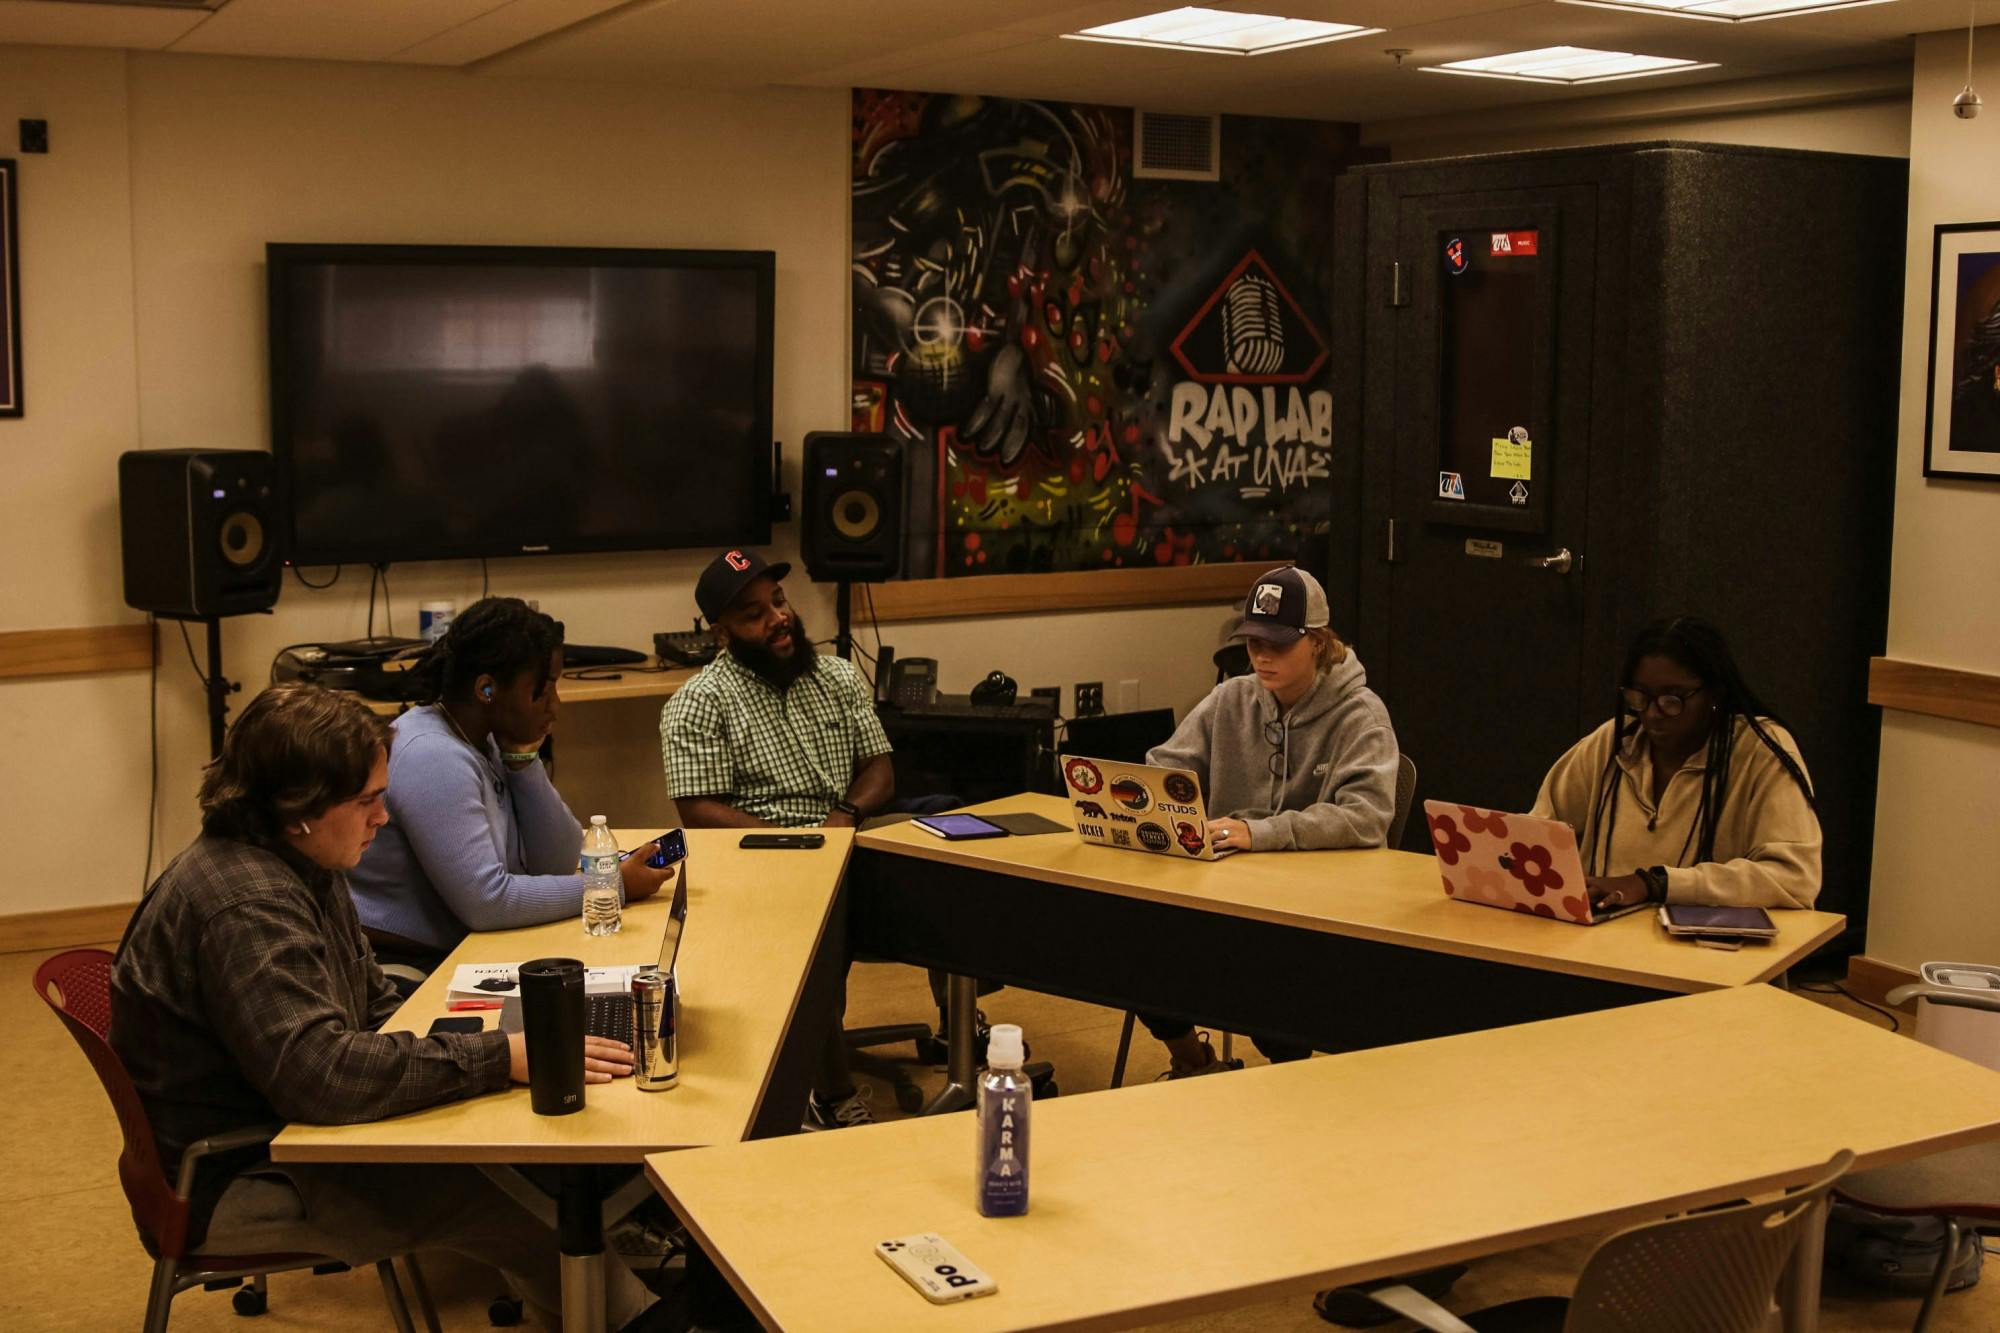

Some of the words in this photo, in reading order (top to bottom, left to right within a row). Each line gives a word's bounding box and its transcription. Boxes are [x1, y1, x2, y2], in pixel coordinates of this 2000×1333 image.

[1262, 386, 1333, 448] LAB
[1253, 445, 1309, 489] UVA
[725, 550, 751, 571] C
[1157, 802, 1198, 816] STUDS
[1078, 822, 1105, 838] LOCKER
[1000, 1097, 1016, 1177] KARMA
